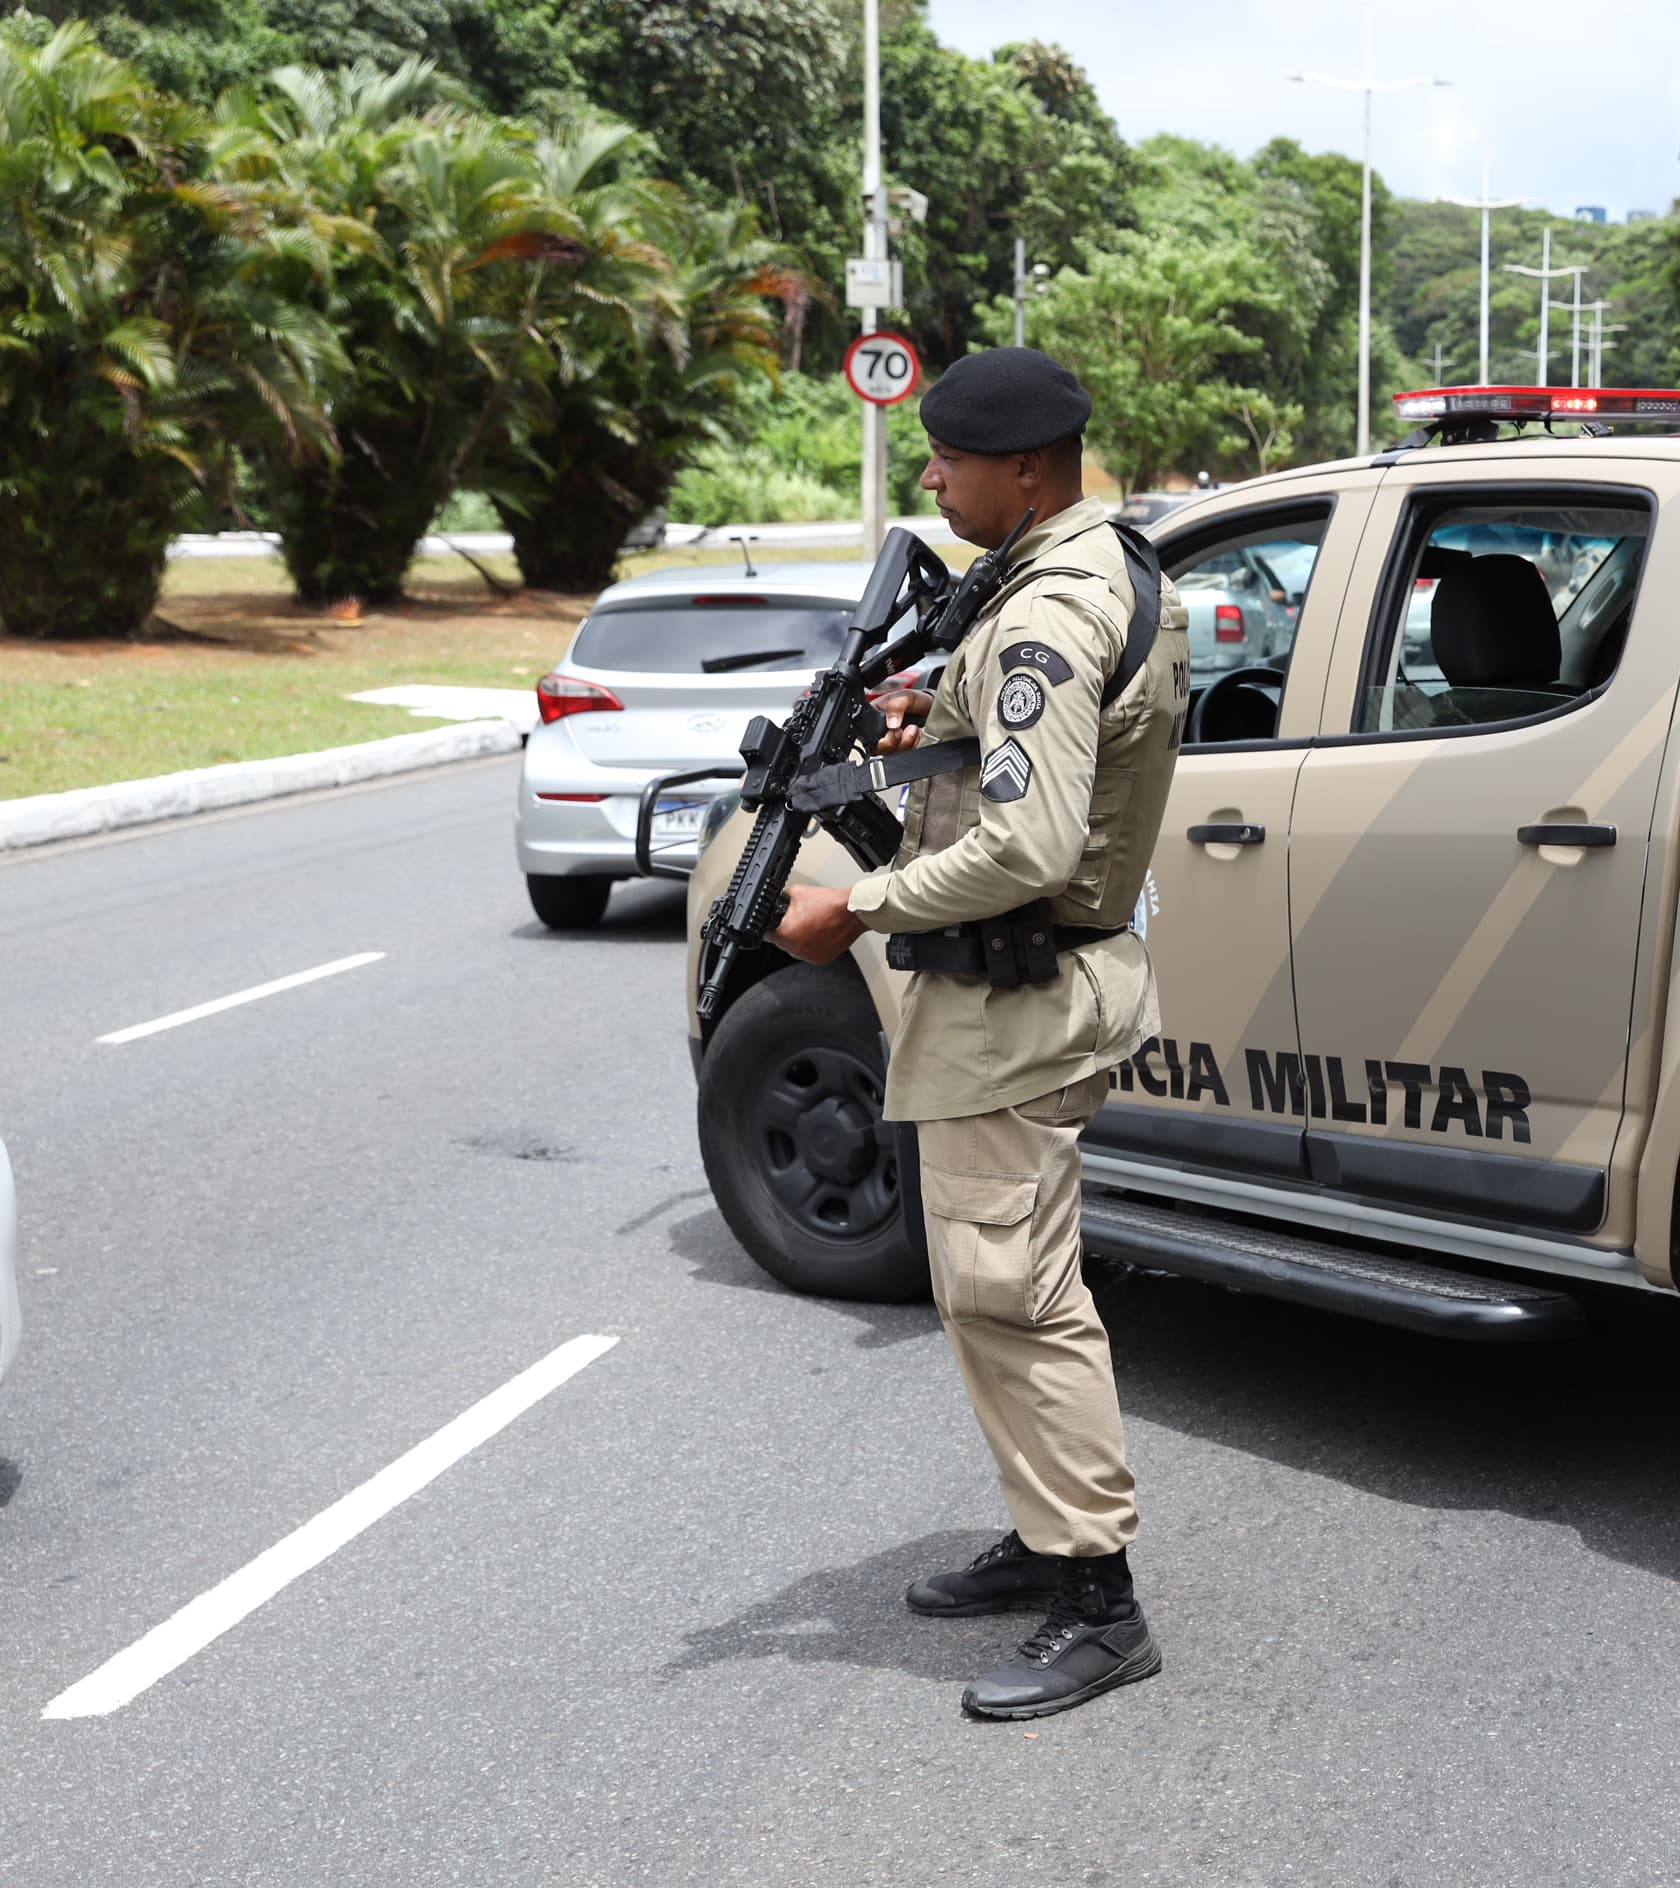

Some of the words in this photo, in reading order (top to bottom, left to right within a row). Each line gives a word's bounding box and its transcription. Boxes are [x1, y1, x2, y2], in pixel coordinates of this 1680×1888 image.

[860, 350, 908, 379] 70
[1020, 647, 1050, 664] CG
[1244, 1048, 1532, 1144] MILITAR
